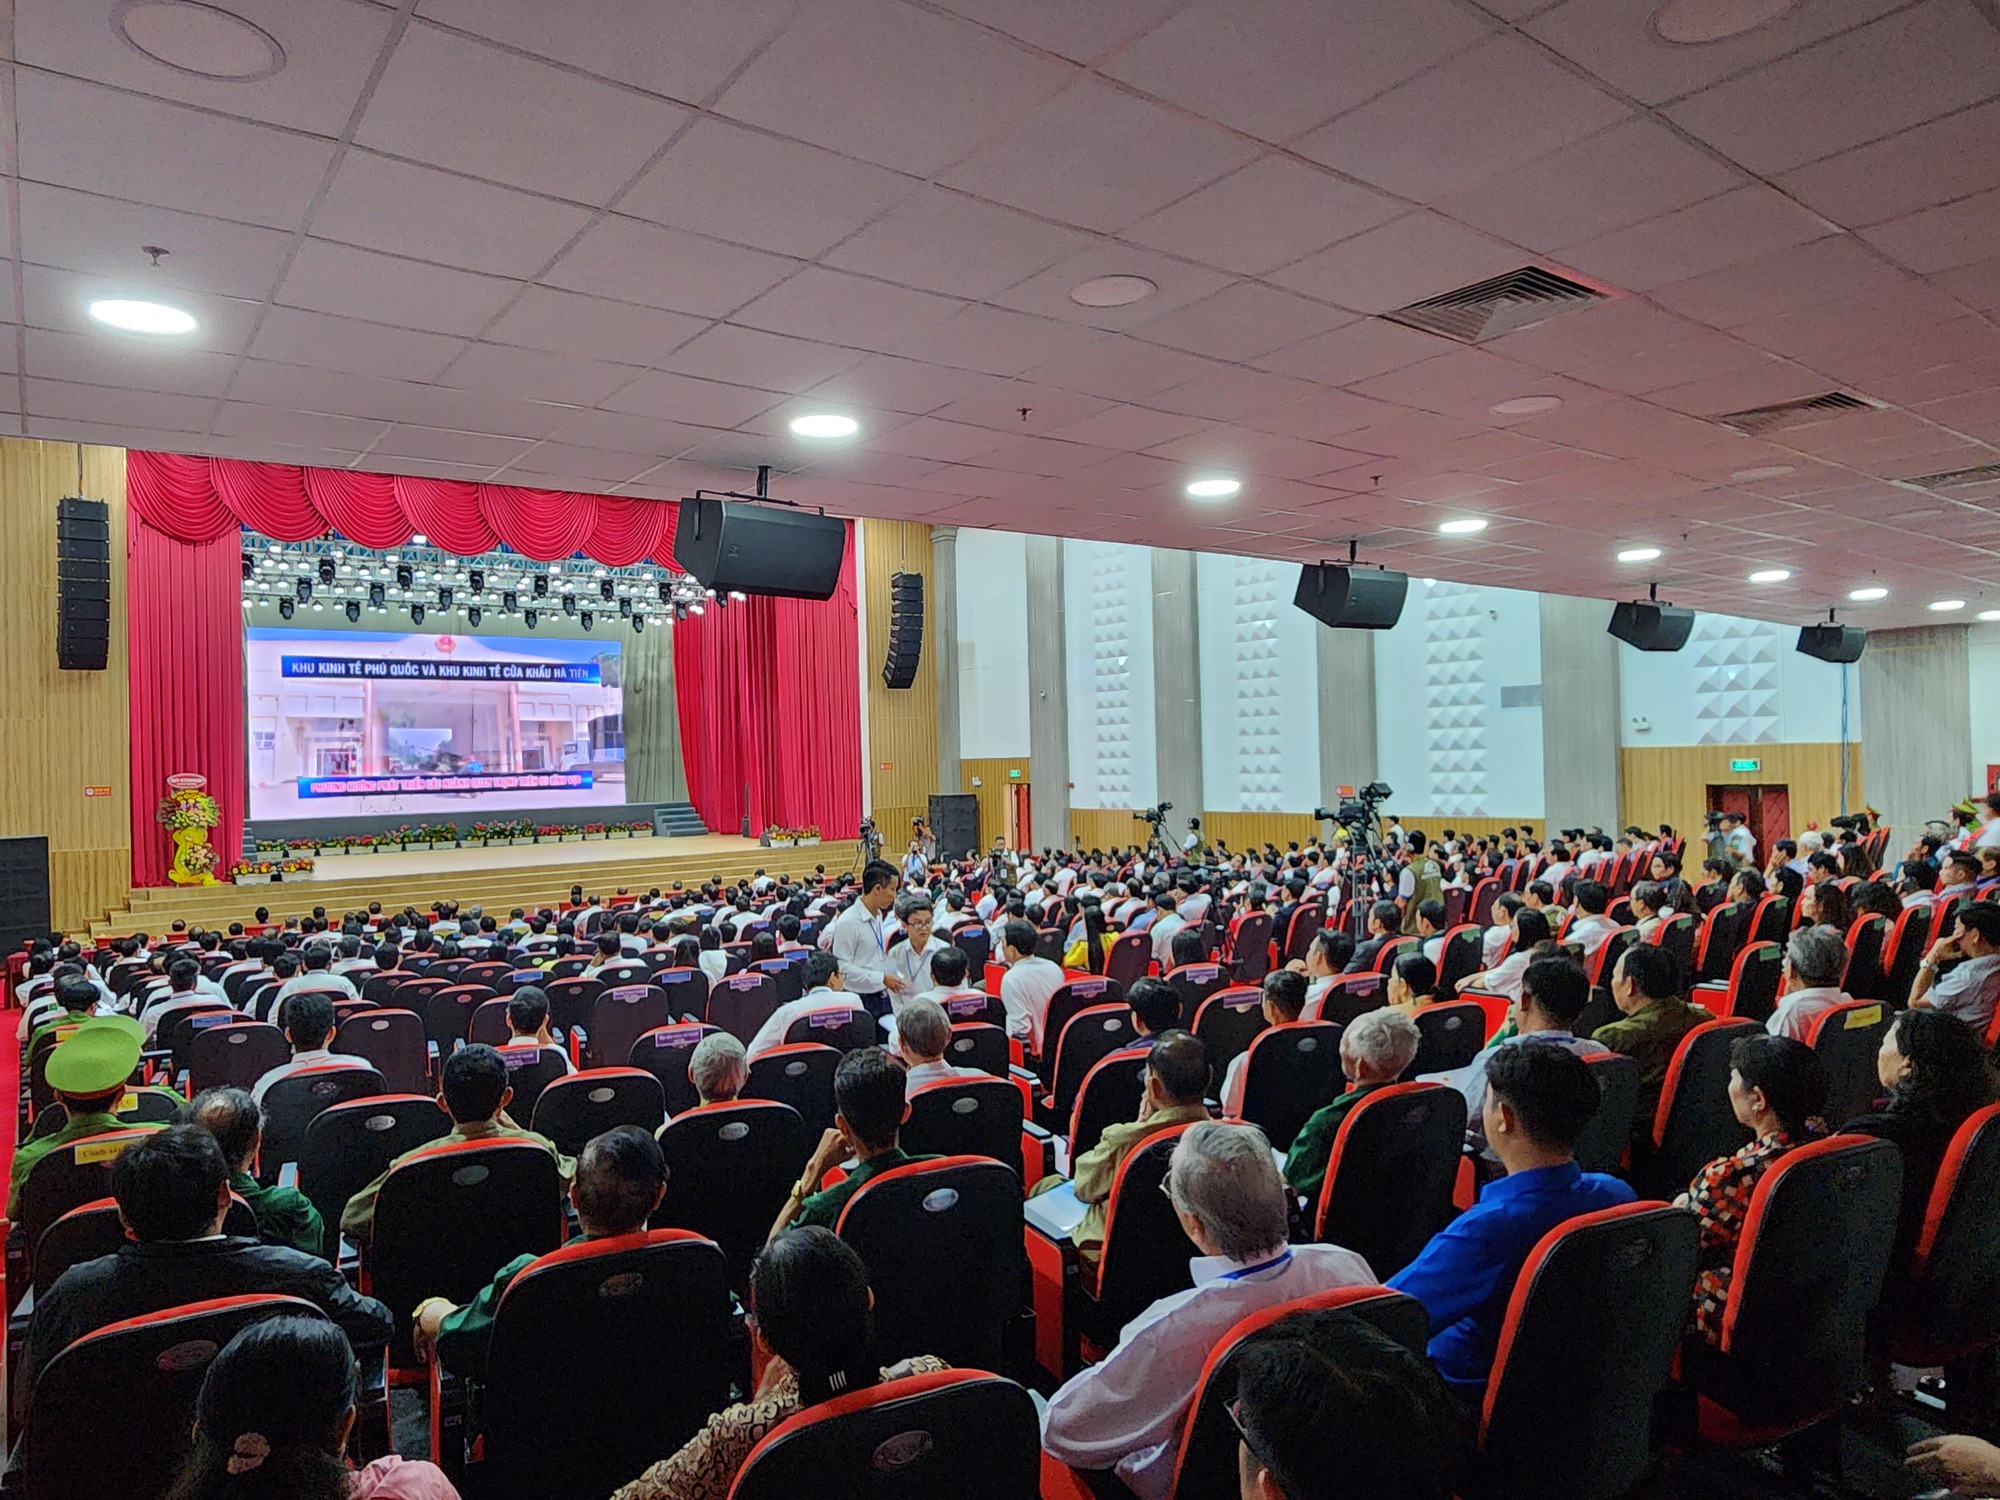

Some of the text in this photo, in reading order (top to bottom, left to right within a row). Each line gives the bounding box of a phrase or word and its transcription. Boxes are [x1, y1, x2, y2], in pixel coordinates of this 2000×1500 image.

[291, 662, 315, 674] KHU
[318, 662, 346, 675] KINH
[347, 659, 362, 675] TẾ
[364, 660, 387, 676] PHÚ
[389, 661, 419, 677] QUỐC
[421, 663, 437, 677] VÀ
[438, 664, 460, 677] KHU
[462, 665, 487, 678] KINH
[553, 666, 567, 679] HÀ
